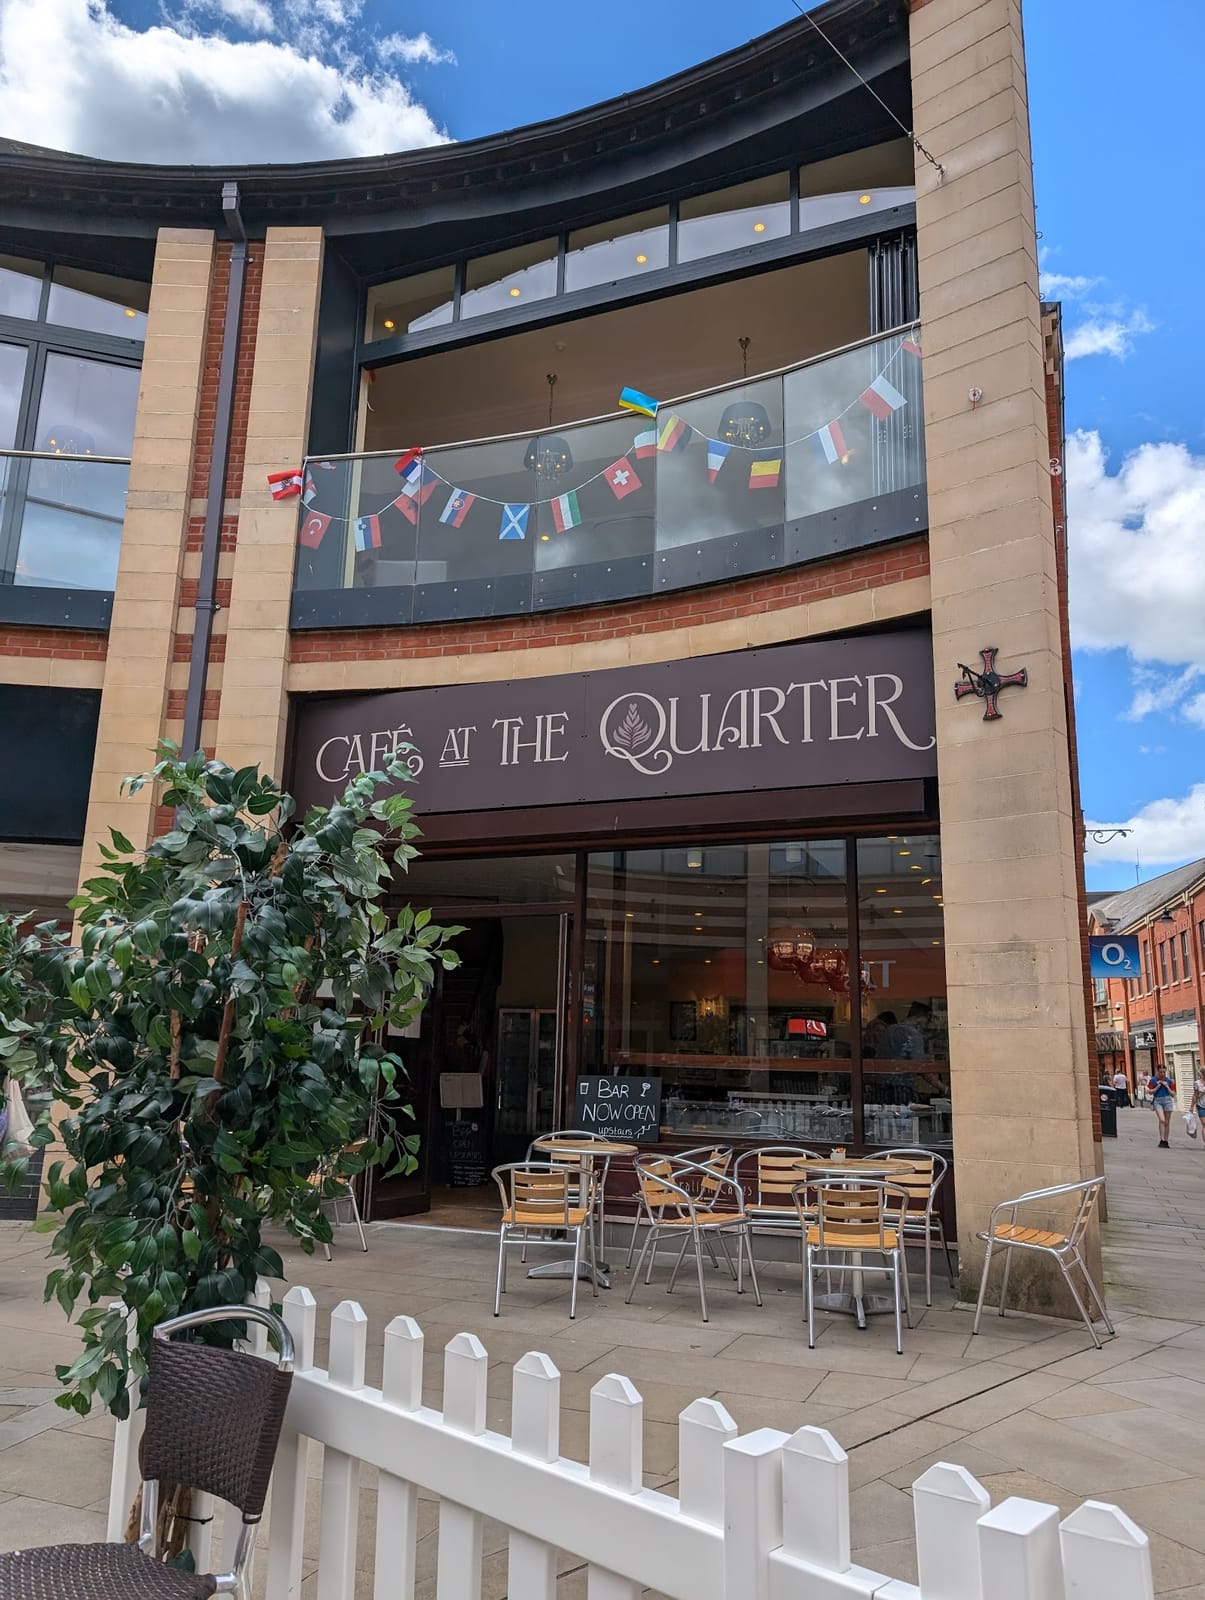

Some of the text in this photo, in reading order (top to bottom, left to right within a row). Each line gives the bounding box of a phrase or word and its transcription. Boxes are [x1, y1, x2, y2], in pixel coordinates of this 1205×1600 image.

[315, 673, 937, 783] CAFÉ AT THE QUARTER
[582, 1102, 656, 1122] NOW OPEN
